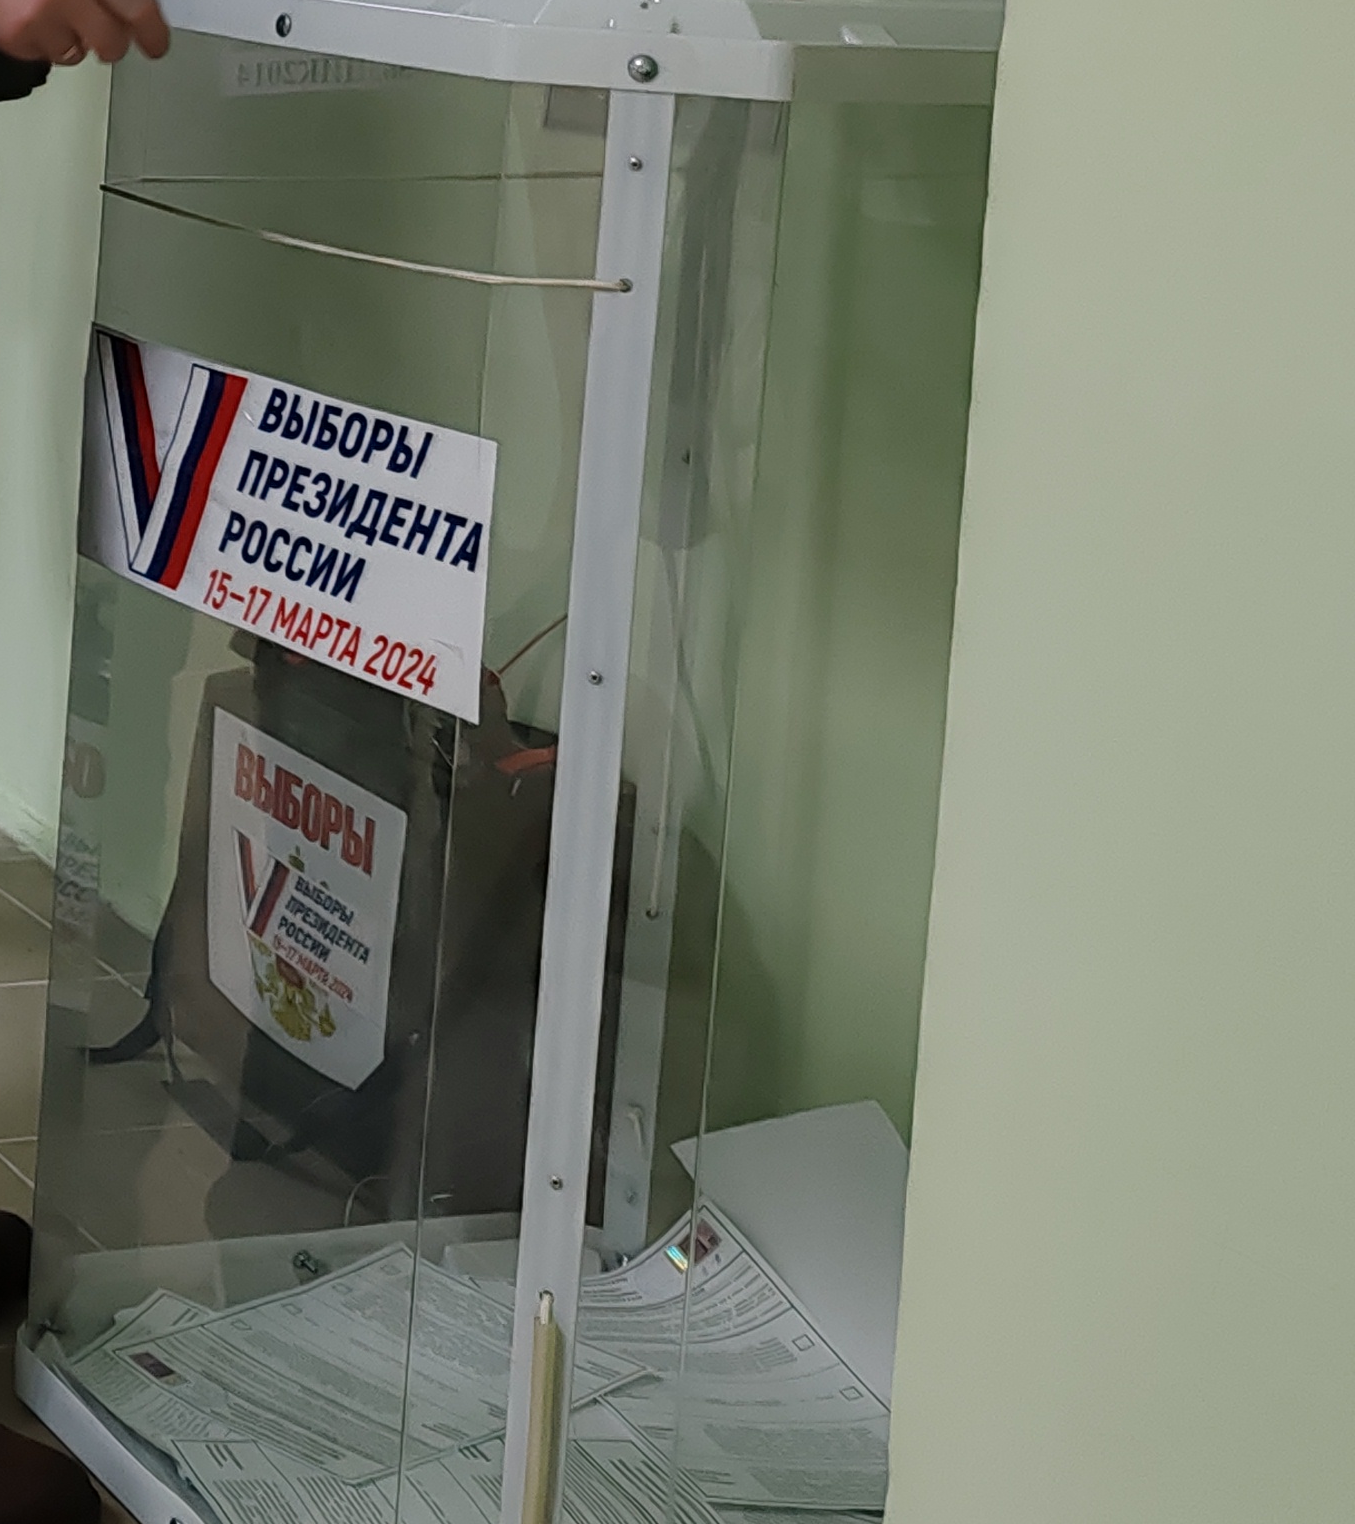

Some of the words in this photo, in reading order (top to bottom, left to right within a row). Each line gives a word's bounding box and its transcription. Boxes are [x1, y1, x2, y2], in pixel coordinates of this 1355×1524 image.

[257, 387, 434, 480] ВЫБОРЫ
[218, 510, 367, 604] РОССИИ
[236, 448, 485, 574] ПРЕЗИДЕНТА
[269, 596, 364, 668] МАРТА
[363, 634, 438, 697] 2024
[234, 743, 376, 878] ВЫБОРЫ
[277, 915, 331, 963] РОССИИ
[285, 894, 370, 965] ПРЕЗИДЕНТА
[294, 875, 354, 926] ВЫБОРЫ
